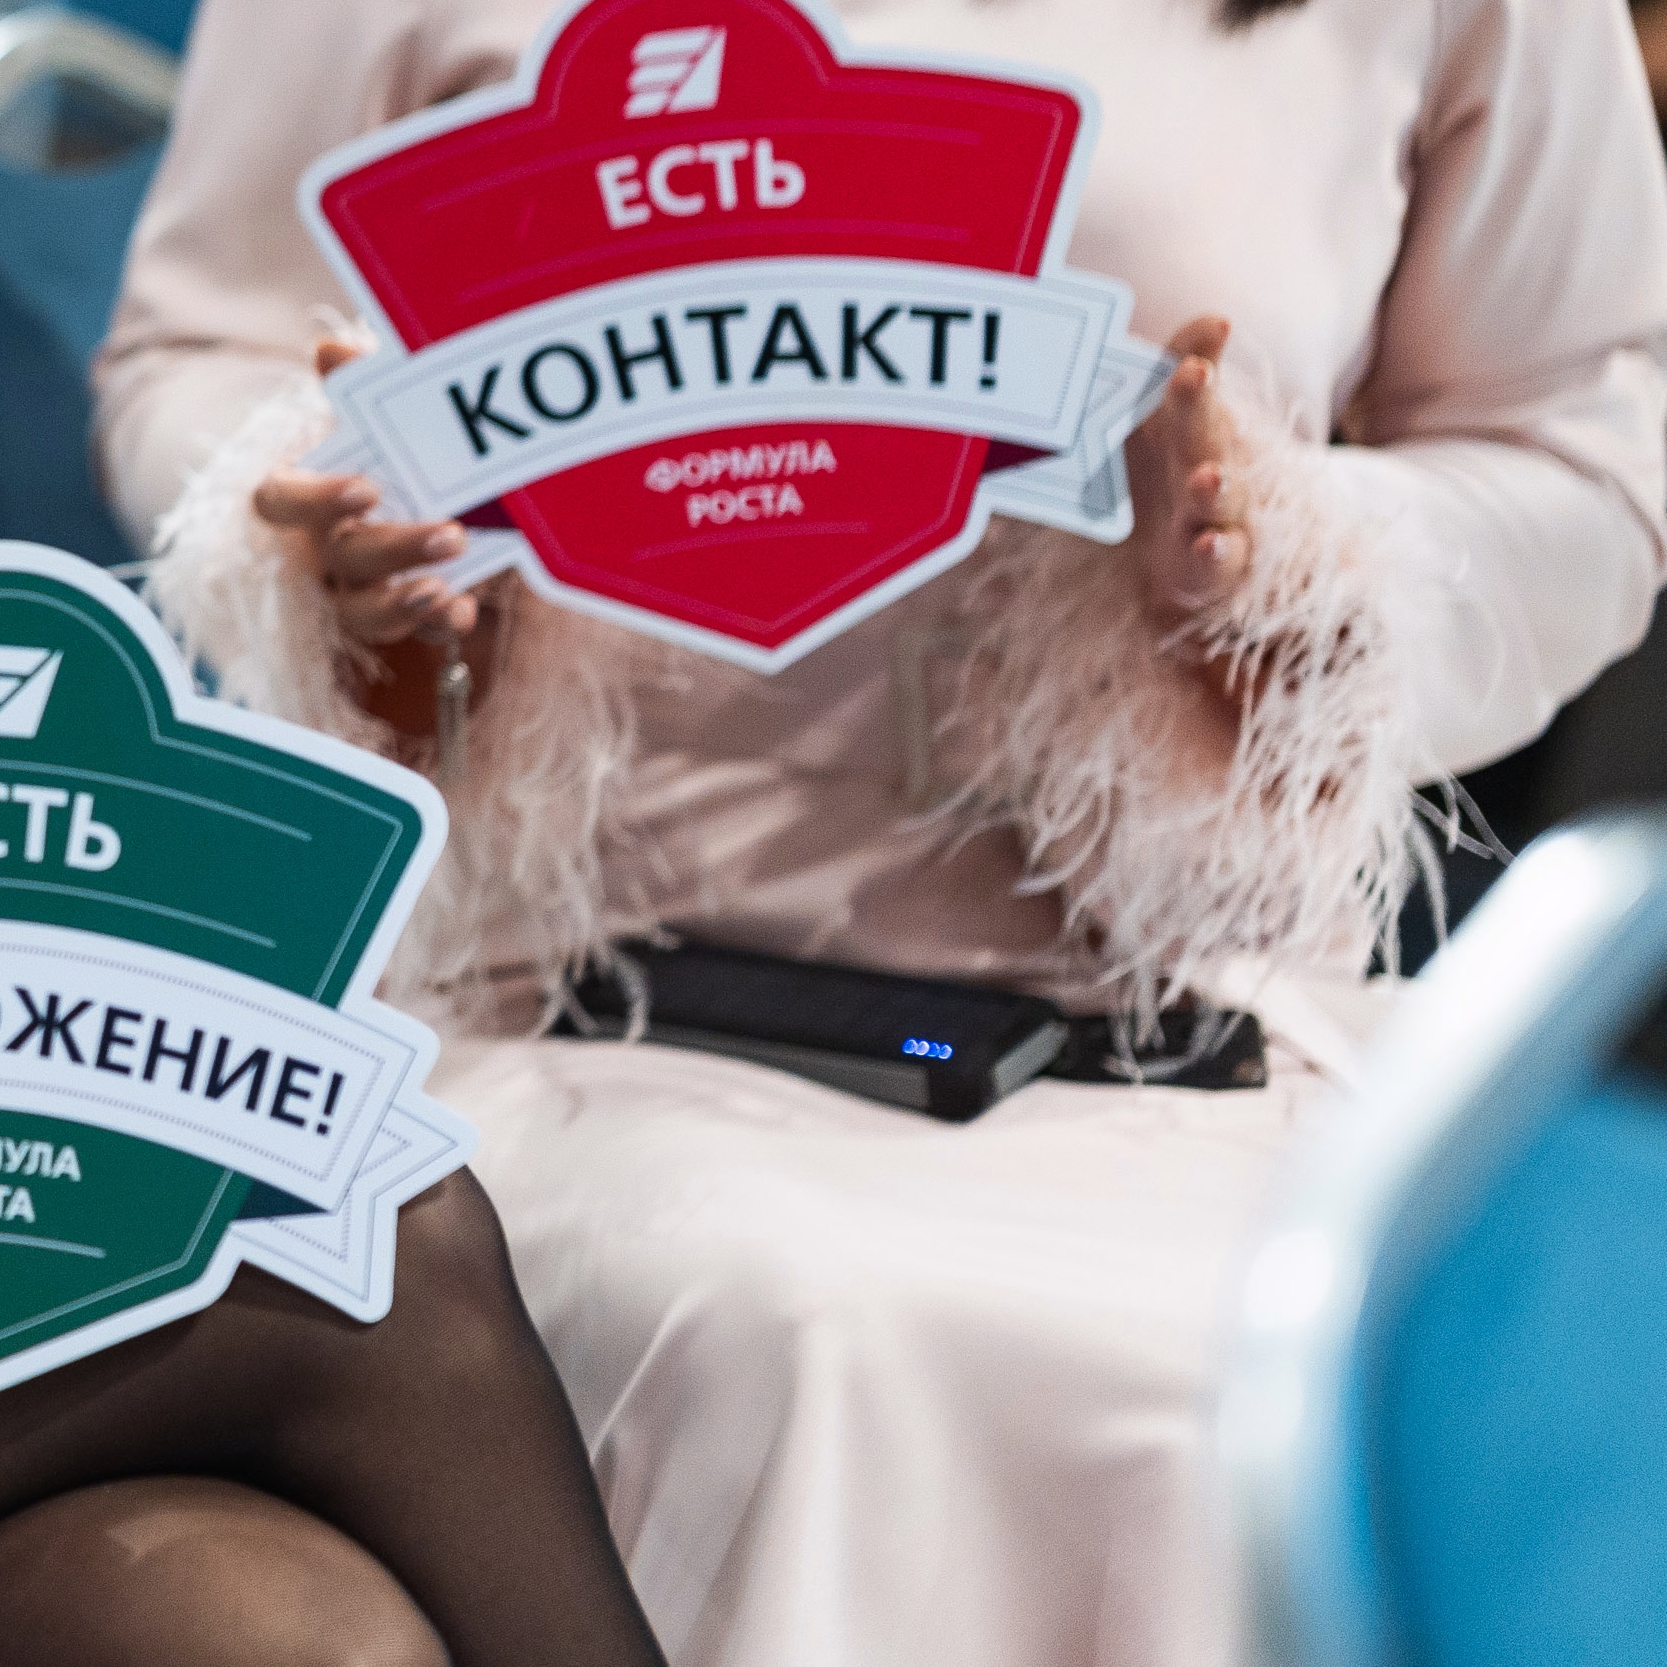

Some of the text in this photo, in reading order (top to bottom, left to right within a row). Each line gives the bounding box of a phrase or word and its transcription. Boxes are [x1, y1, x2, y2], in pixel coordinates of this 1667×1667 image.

[597, 139, 806, 229] ЕСТЬ
[446, 301, 1002, 455] КОНТАКТ!
[647, 441, 837, 493] ФОРМУЛА
[687, 487, 803, 527] РОСТА
